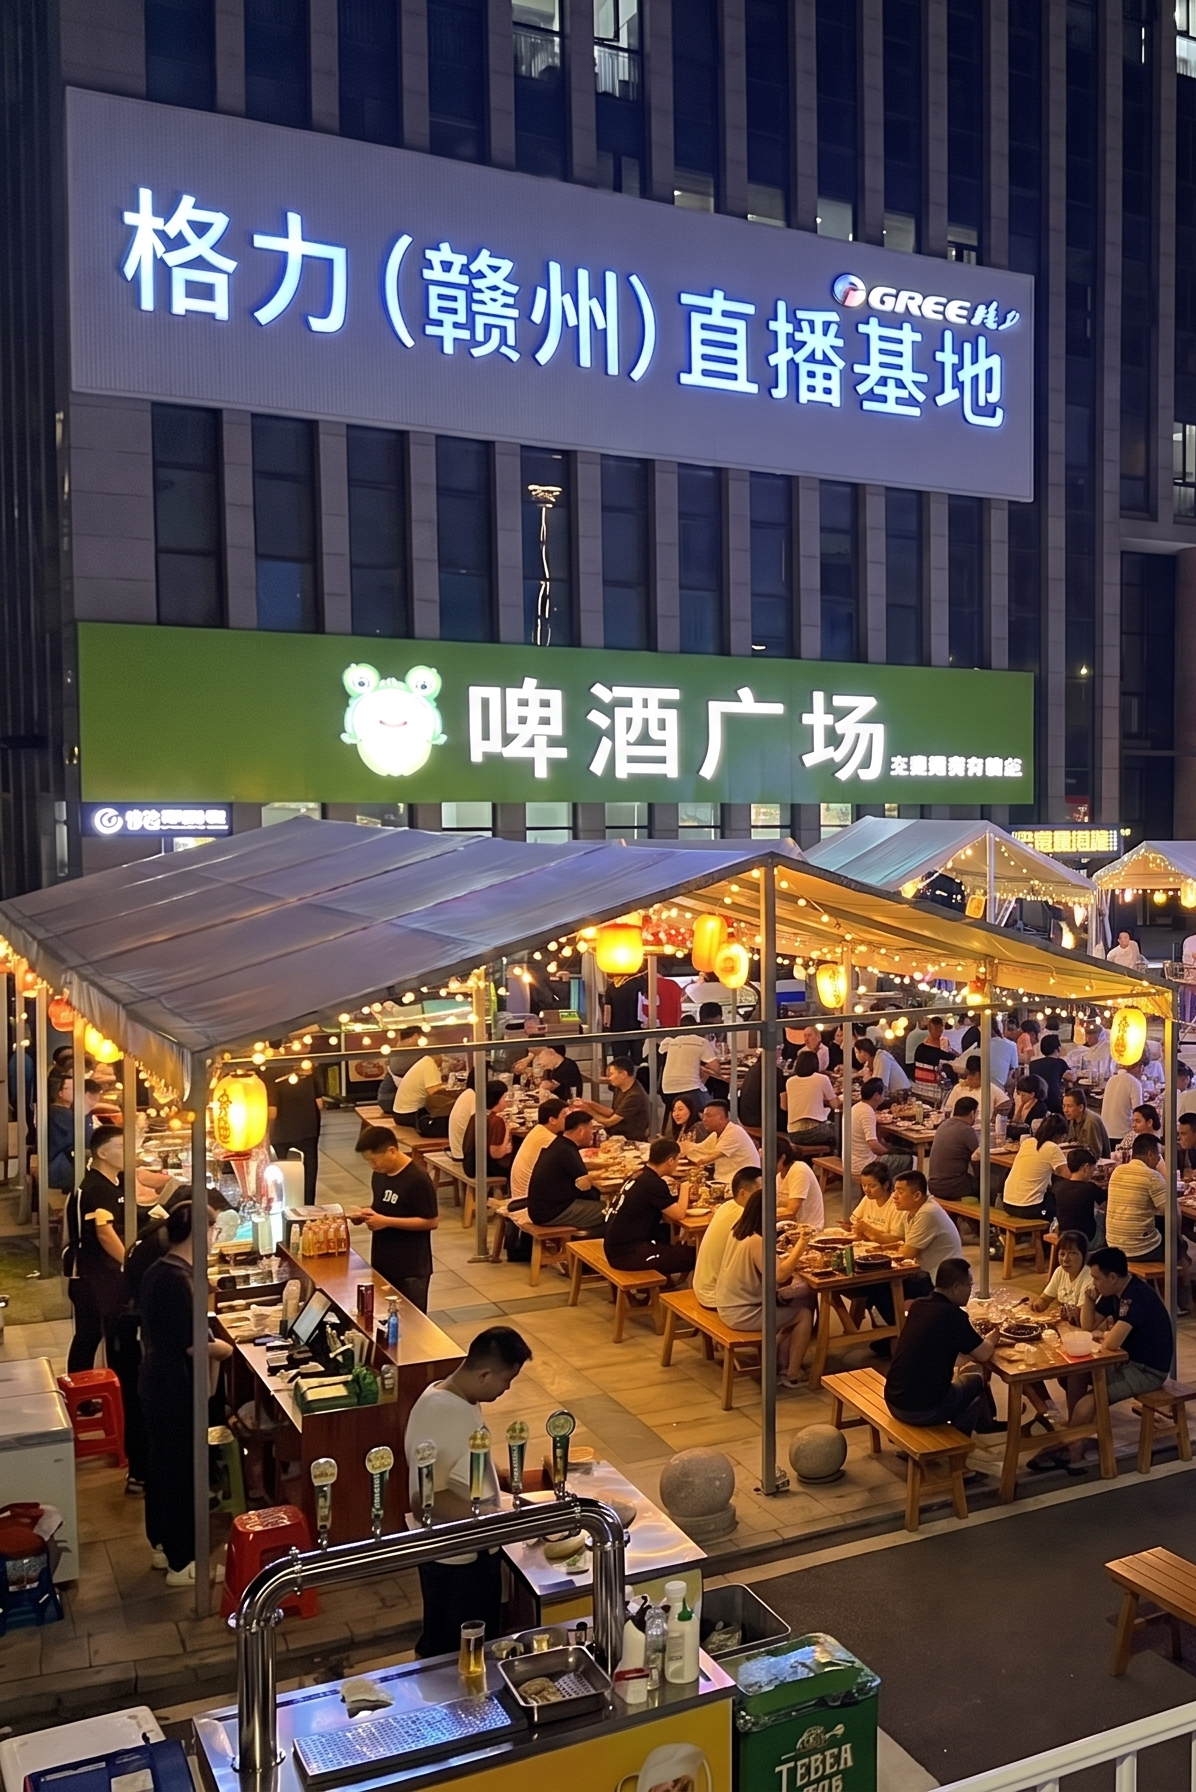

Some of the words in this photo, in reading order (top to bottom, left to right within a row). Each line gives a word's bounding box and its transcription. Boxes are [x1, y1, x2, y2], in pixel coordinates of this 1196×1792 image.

[867, 286, 971, 326] GREE
[468, 677, 885, 781] 啤酒广场
